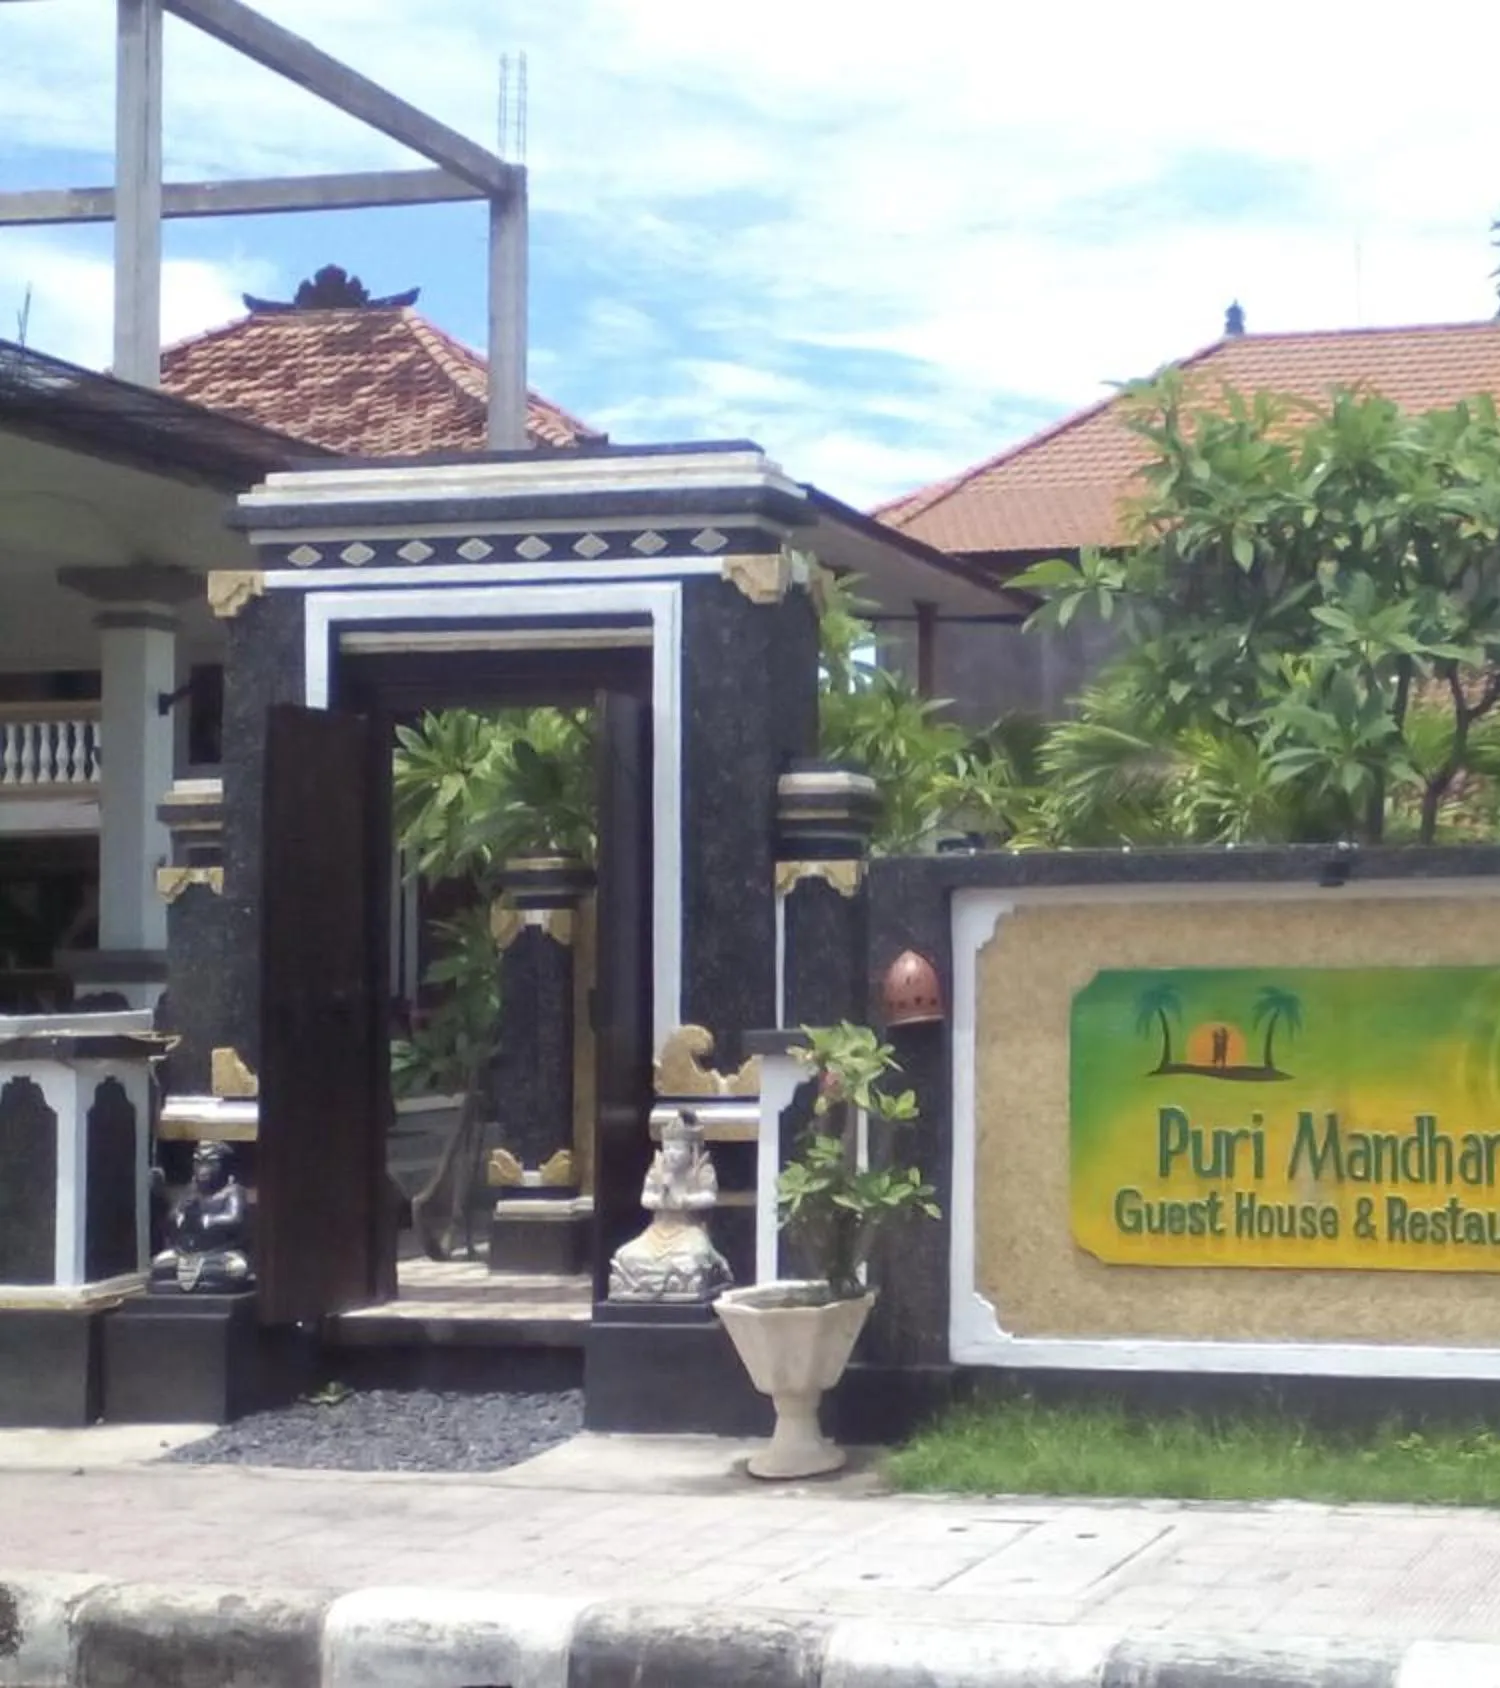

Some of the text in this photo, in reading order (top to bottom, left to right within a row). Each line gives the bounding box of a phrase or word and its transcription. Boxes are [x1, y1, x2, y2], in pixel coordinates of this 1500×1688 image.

[1158, 1106, 1265, 1180] Puri
[1114, 1189, 1225, 1236] Guest
[1234, 1191, 1339, 1240] House
[1354, 1197, 1378, 1242] &
